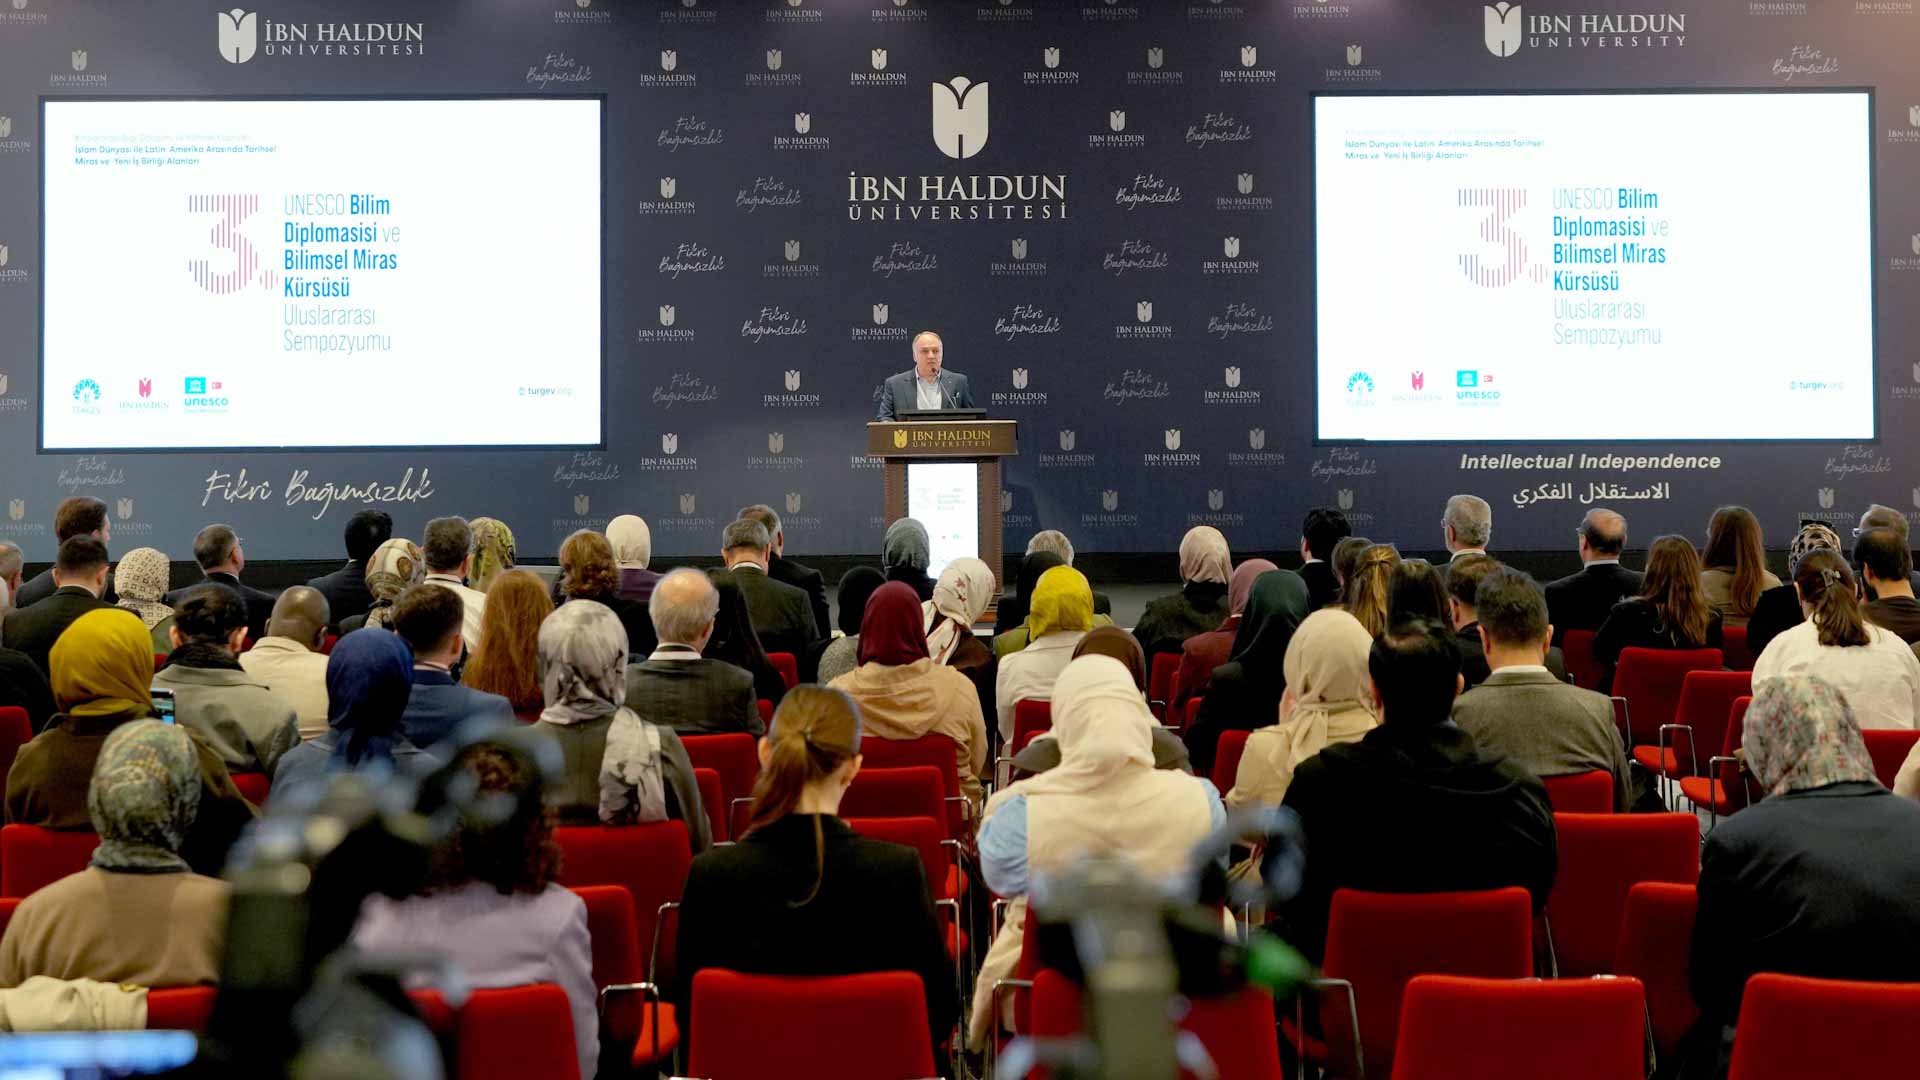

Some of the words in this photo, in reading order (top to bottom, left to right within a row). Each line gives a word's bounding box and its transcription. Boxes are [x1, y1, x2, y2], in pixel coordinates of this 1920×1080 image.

[266, 20, 306, 41] İBN
[318, 24, 422, 41] HALDUN
[1530, 16, 1570, 33] IBN
[1582, 14, 1685, 33] HALDUN
[1530, 36, 1685, 47] UNIVERSITY
[145, 145, 166, 154] Latin
[169, 145, 204, 154] Amerika
[75, 157, 98, 166] Miras
[100, 157, 110, 166] ve
[848, 172, 906, 201] İBN
[920, 176, 1066, 200] HALDUN
[285, 194, 344, 216] UNESCO
[350, 194, 390, 214] Bilim
[1553, 188, 1612, 210] UNESCO
[1618, 189, 1658, 208] Bilim
[849, 203, 1065, 220] ÜNİVERSİTESİ
[285, 222, 377, 246] Diplomasisi
[382, 226, 400, 242] ve
[1554, 216, 1645, 240] Diplomasisi
[1651, 220, 1669, 236] ve
[285, 250, 348, 270] Bilimsel
[353, 250, 397, 270] Miras
[1554, 243, 1616, 264] Bilimsel
[1622, 243, 1666, 264] Miras
[285, 277, 350, 297] Kürsüsü
[1554, 271, 1619, 290] Kürsüsü
[284, 304, 375, 325] Uluslararası
[1554, 298, 1646, 319] Uluslararası
[284, 329, 391, 354] Sempozyumu
[1554, 323, 1661, 349] Sempozyumu
[184, 397, 228, 406] unesco
[1457, 390, 1501, 399] unesco
[938, 430, 990, 440] HALDUN
[1461, 454, 1573, 469] Intellectual
[1580, 454, 1721, 472] Independence
[1513, 483, 1572, 508] الفكري
[1580, 483, 1669, 504] الاستقلال
